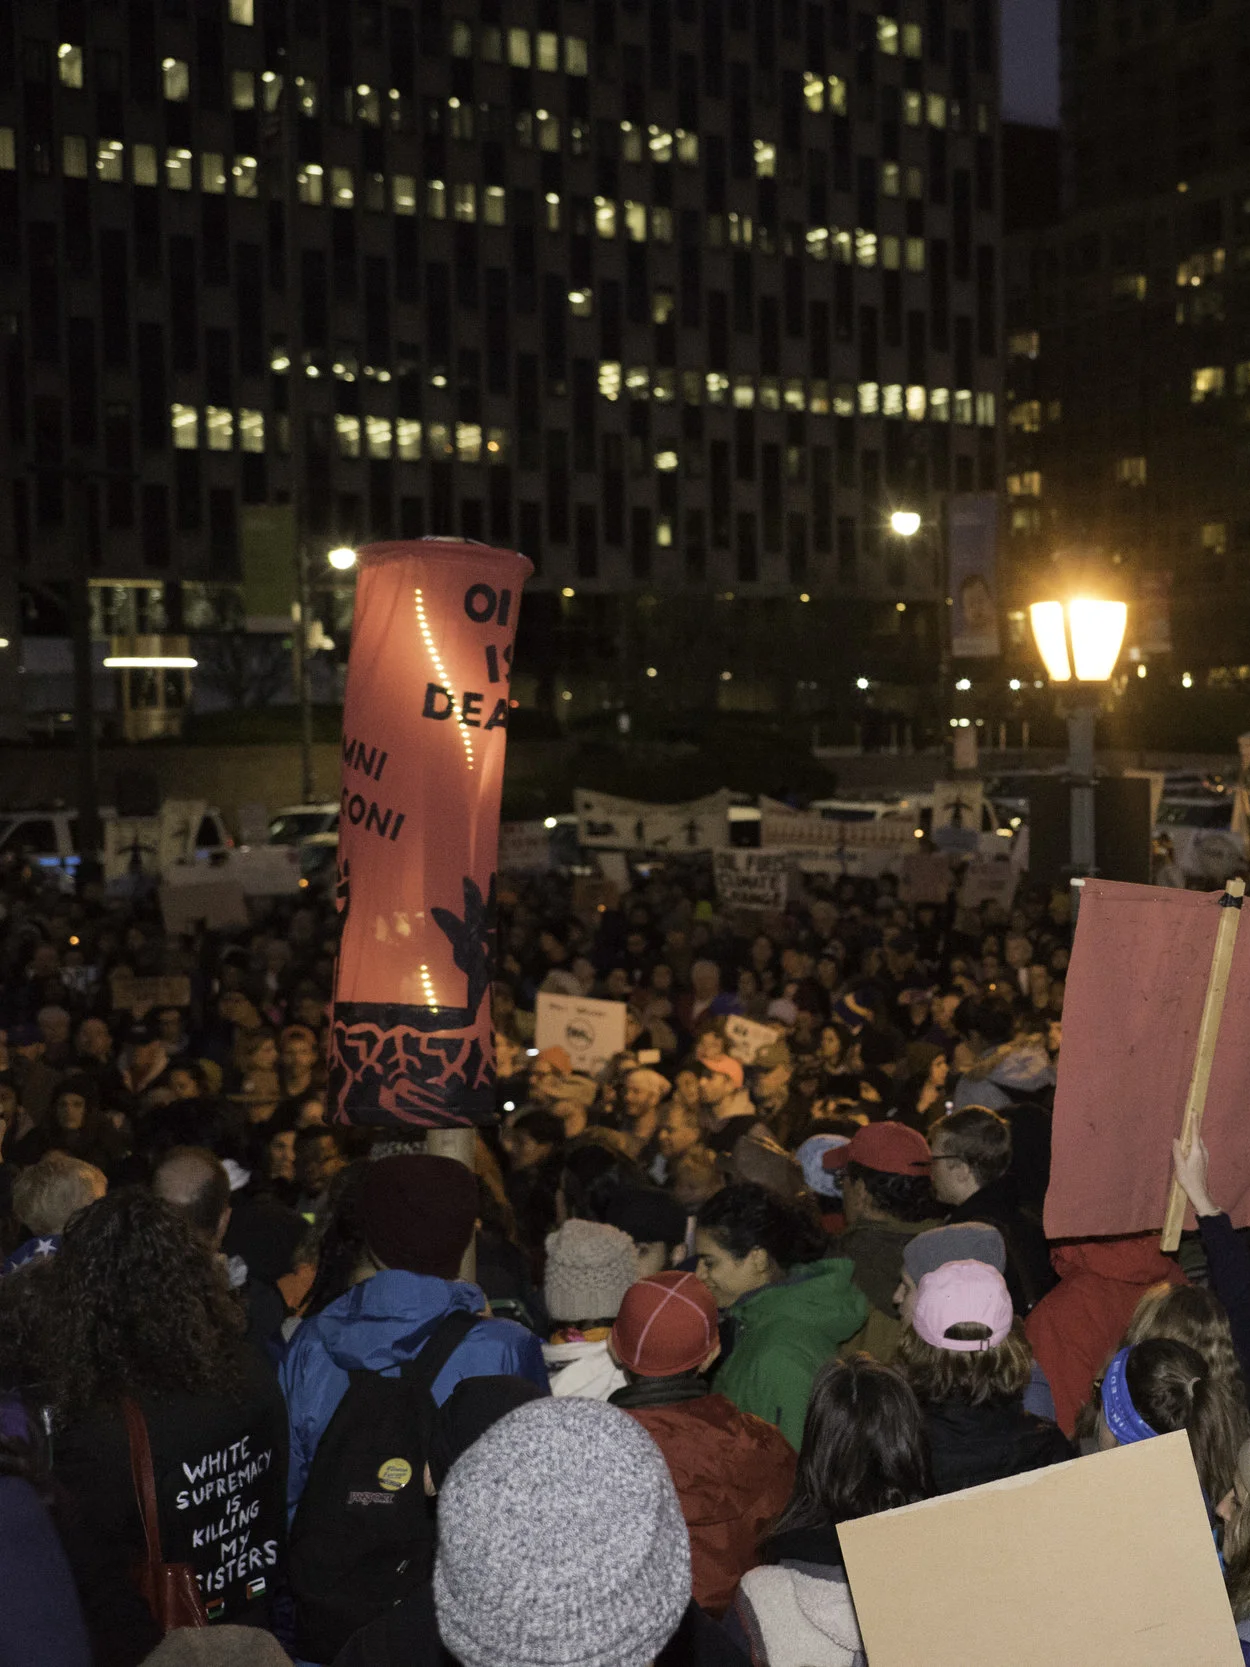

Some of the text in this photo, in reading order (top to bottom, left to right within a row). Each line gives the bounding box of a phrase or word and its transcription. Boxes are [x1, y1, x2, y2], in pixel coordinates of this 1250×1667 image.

[176, 1449, 272, 1510] SUPREMACY
[182, 1435, 250, 1484] WHITE
[192, 1500, 260, 1548] KILLING
[226, 1494, 242, 1515] IS
[221, 1530, 250, 1562] MY
